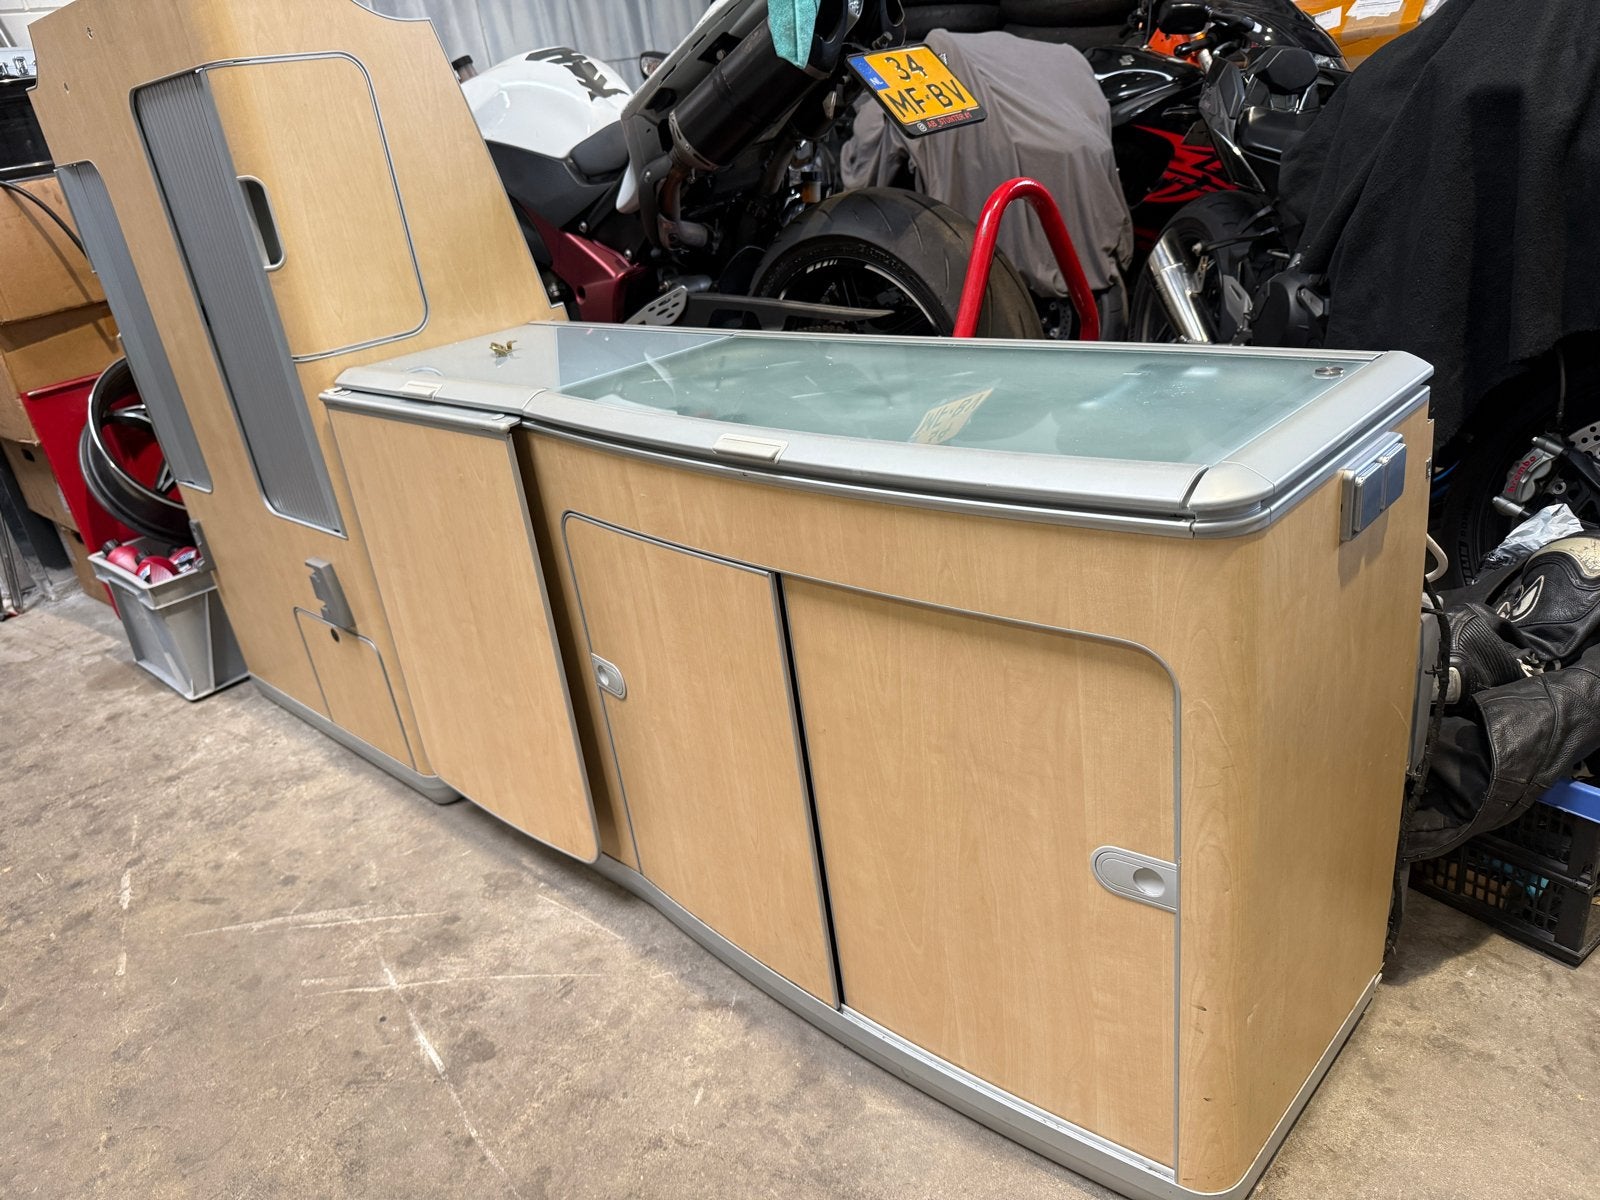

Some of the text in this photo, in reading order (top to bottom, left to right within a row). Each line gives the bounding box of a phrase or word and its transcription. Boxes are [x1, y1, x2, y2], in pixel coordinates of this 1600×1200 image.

[869, 77, 883, 86] NL
[884, 53, 928, 81] 34
[884, 79, 967, 118] MF-BV
[1506, 456, 1537, 493] brembo
